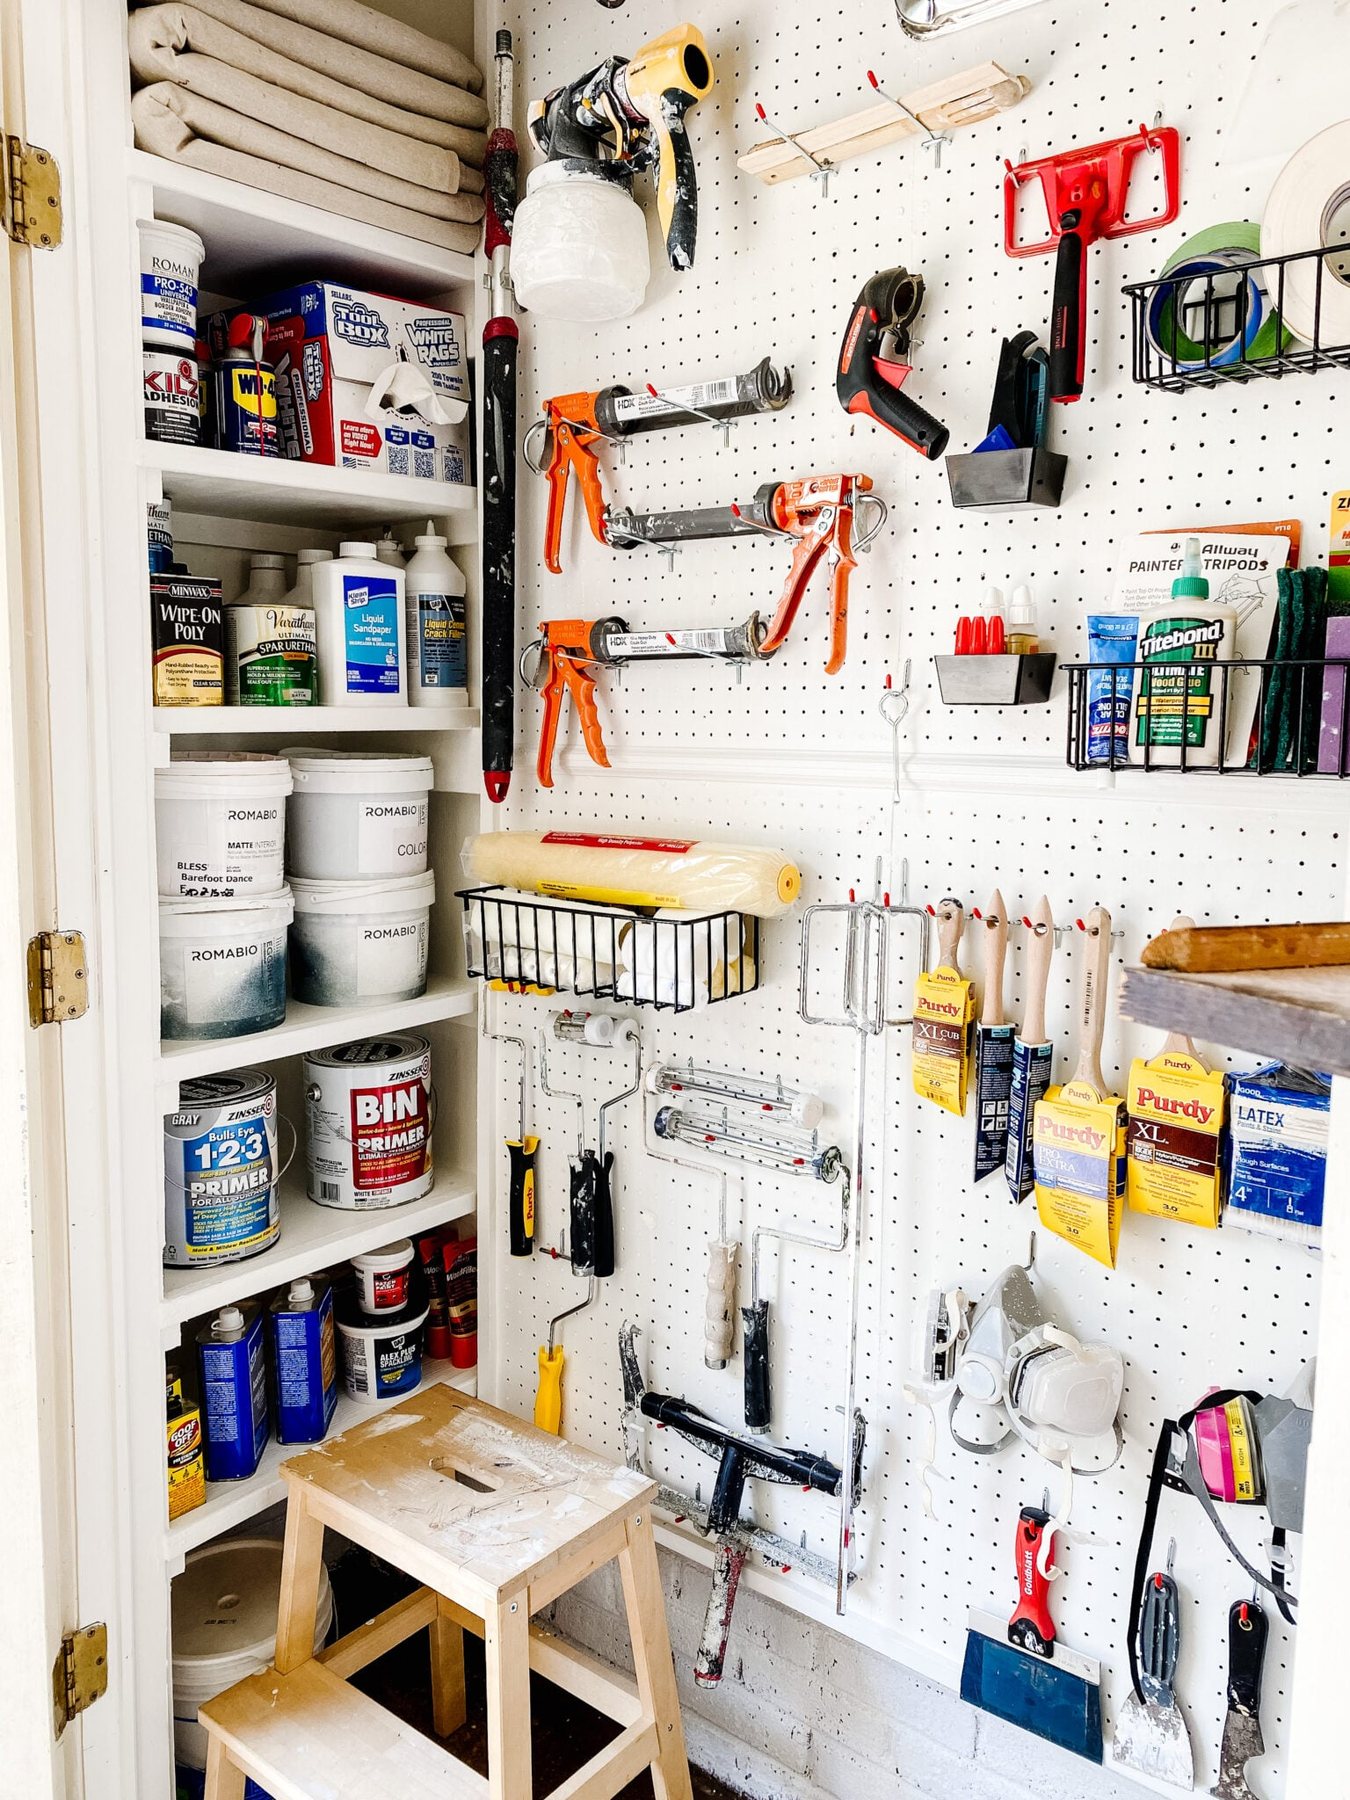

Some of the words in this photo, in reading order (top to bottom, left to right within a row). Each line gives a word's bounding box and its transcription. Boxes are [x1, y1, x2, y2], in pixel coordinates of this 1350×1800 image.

[153, 257, 194, 279] ROMAN
[154, 277, 193, 296] PRO-543
[160, 289, 190, 302] UNIVERSAL
[331, 290, 352, 302] SELLARS
[155, 302, 174, 311] BORDER
[335, 305, 380, 326] TOOL
[415, 319, 451, 327] PROFESSIONAL
[337, 320, 386, 343] BOX
[405, 324, 454, 345] WHITE
[418, 343, 459, 367] RAGS
[144, 370, 198, 399] KILZ
[238, 374, 276, 399] WD-4
[617, 399, 635, 409] HDX
[292, 373, 312, 452] PROFESSIONAL
[352, 432, 368, 441] VIDEO
[343, 439, 359, 448] Right
[148, 505, 169, 519] thane
[1202, 544, 1259, 557] Allway
[1204, 558, 1269, 571] TRIPODS
[171, 585, 208, 597] MINWAX
[349, 590, 367, 600] Klean
[350, 597, 366, 606] Strip
[361, 614, 384, 626] Liquid
[424, 620, 447, 629] Liquid
[174, 622, 206, 641] POLY
[278, 632, 311, 640] ULTIMATE
[353, 623, 392, 636] Sandpaper
[424, 629, 447, 638] Crack
[610, 636, 627, 646] HDX
[1141, 622, 1220, 657] Titebond
[260, 641, 285, 654] SPAR
[285, 641, 316, 654] URETHA
[1193, 643, 1215, 659] III
[1101, 674, 1128, 682] SEAANT
[1176, 677, 1201, 688] Gue
[1097, 702, 1128, 712] SILIONE
[1100, 710, 1125, 718] CLAR
[228, 809, 277, 820] ROMABIO
[365, 805, 417, 817] ROMABIO
[177, 862, 208, 871] BLESS
[181, 873, 223, 882] Barefoot
[364, 925, 416, 940] ROMABIO
[192, 945, 258, 962] ROMABIO
[936, 974, 956, 983] Purdy
[917, 997, 961, 1017] Purdy
[917, 1022, 943, 1041] XL
[940, 1029, 960, 1040] CUB
[1164, 1059, 1192, 1071] Purdy
[388, 1064, 423, 1081] ZINSSER
[1068, 1088, 1092, 1100] Purdy
[227, 1103, 266, 1121] ZINSSER
[1137, 1087, 1215, 1124] Purdy
[172, 1114, 200, 1125] GRAY
[1238, 1106, 1285, 1128] LATEX
[209, 1130, 236, 1142] Bulls
[237, 1126, 255, 1138] Eye
[358, 1125, 425, 1153] PRIMER
[1038, 1115, 1106, 1150] Purdy
[1039, 1156, 1076, 1173] EXTRA
[1259, 1160, 1289, 1172] Surfaces
[190, 1167, 269, 1199] PRIMER
[191, 1199, 212, 1207] FOR
[215, 1196, 231, 1204] ALL
[380, 1351, 399, 1361] ALEX
[400, 1344, 416, 1357] PLUS
[380, 1353, 413, 1368] SPACKLING
[171, 1419, 196, 1442] GOOF
[175, 1430, 193, 1448] OFF
[1239, 1482, 1245, 1493] 3M
[1024, 1550, 1033, 1596] Goldblatt
